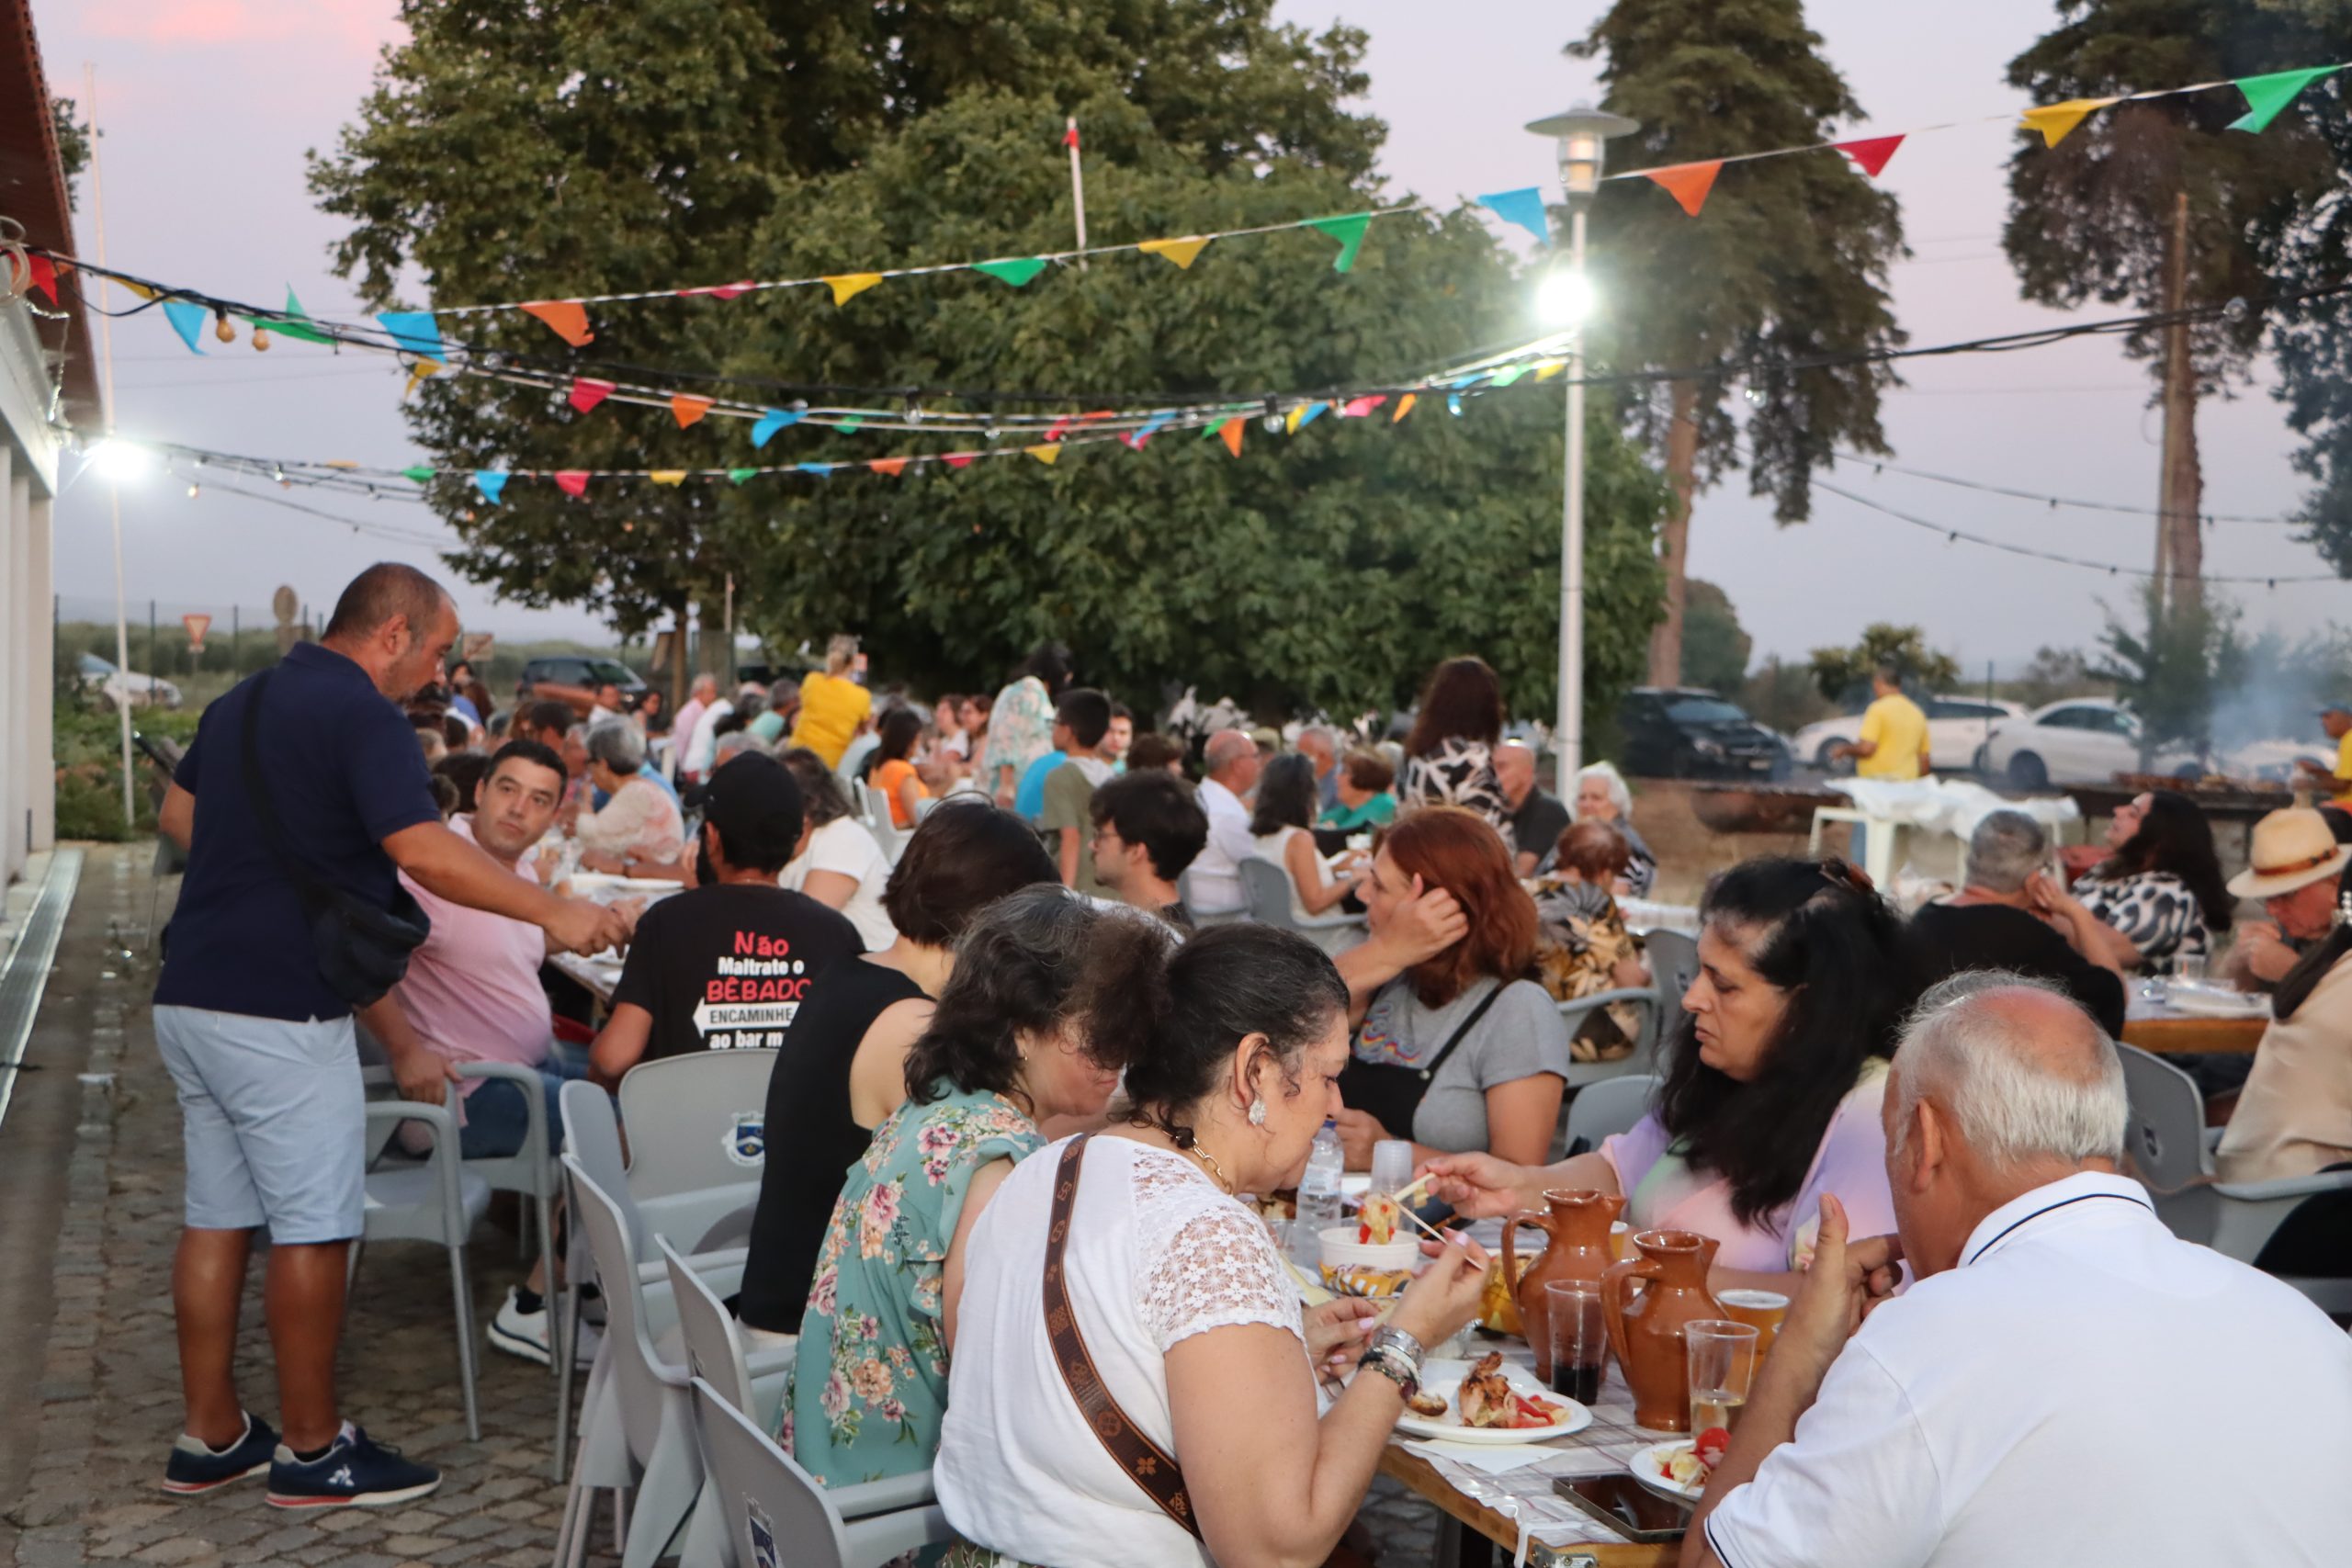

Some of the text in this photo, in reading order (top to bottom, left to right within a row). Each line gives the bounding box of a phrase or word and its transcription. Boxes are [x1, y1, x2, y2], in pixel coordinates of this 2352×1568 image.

[735, 931, 789, 956] Não
[718, 956, 805, 976] Maltrate o
[709, 1007, 793, 1023] ENCAMINHE
[709, 1032, 731, 1050] ao
[736, 1029, 763, 1048] bar
